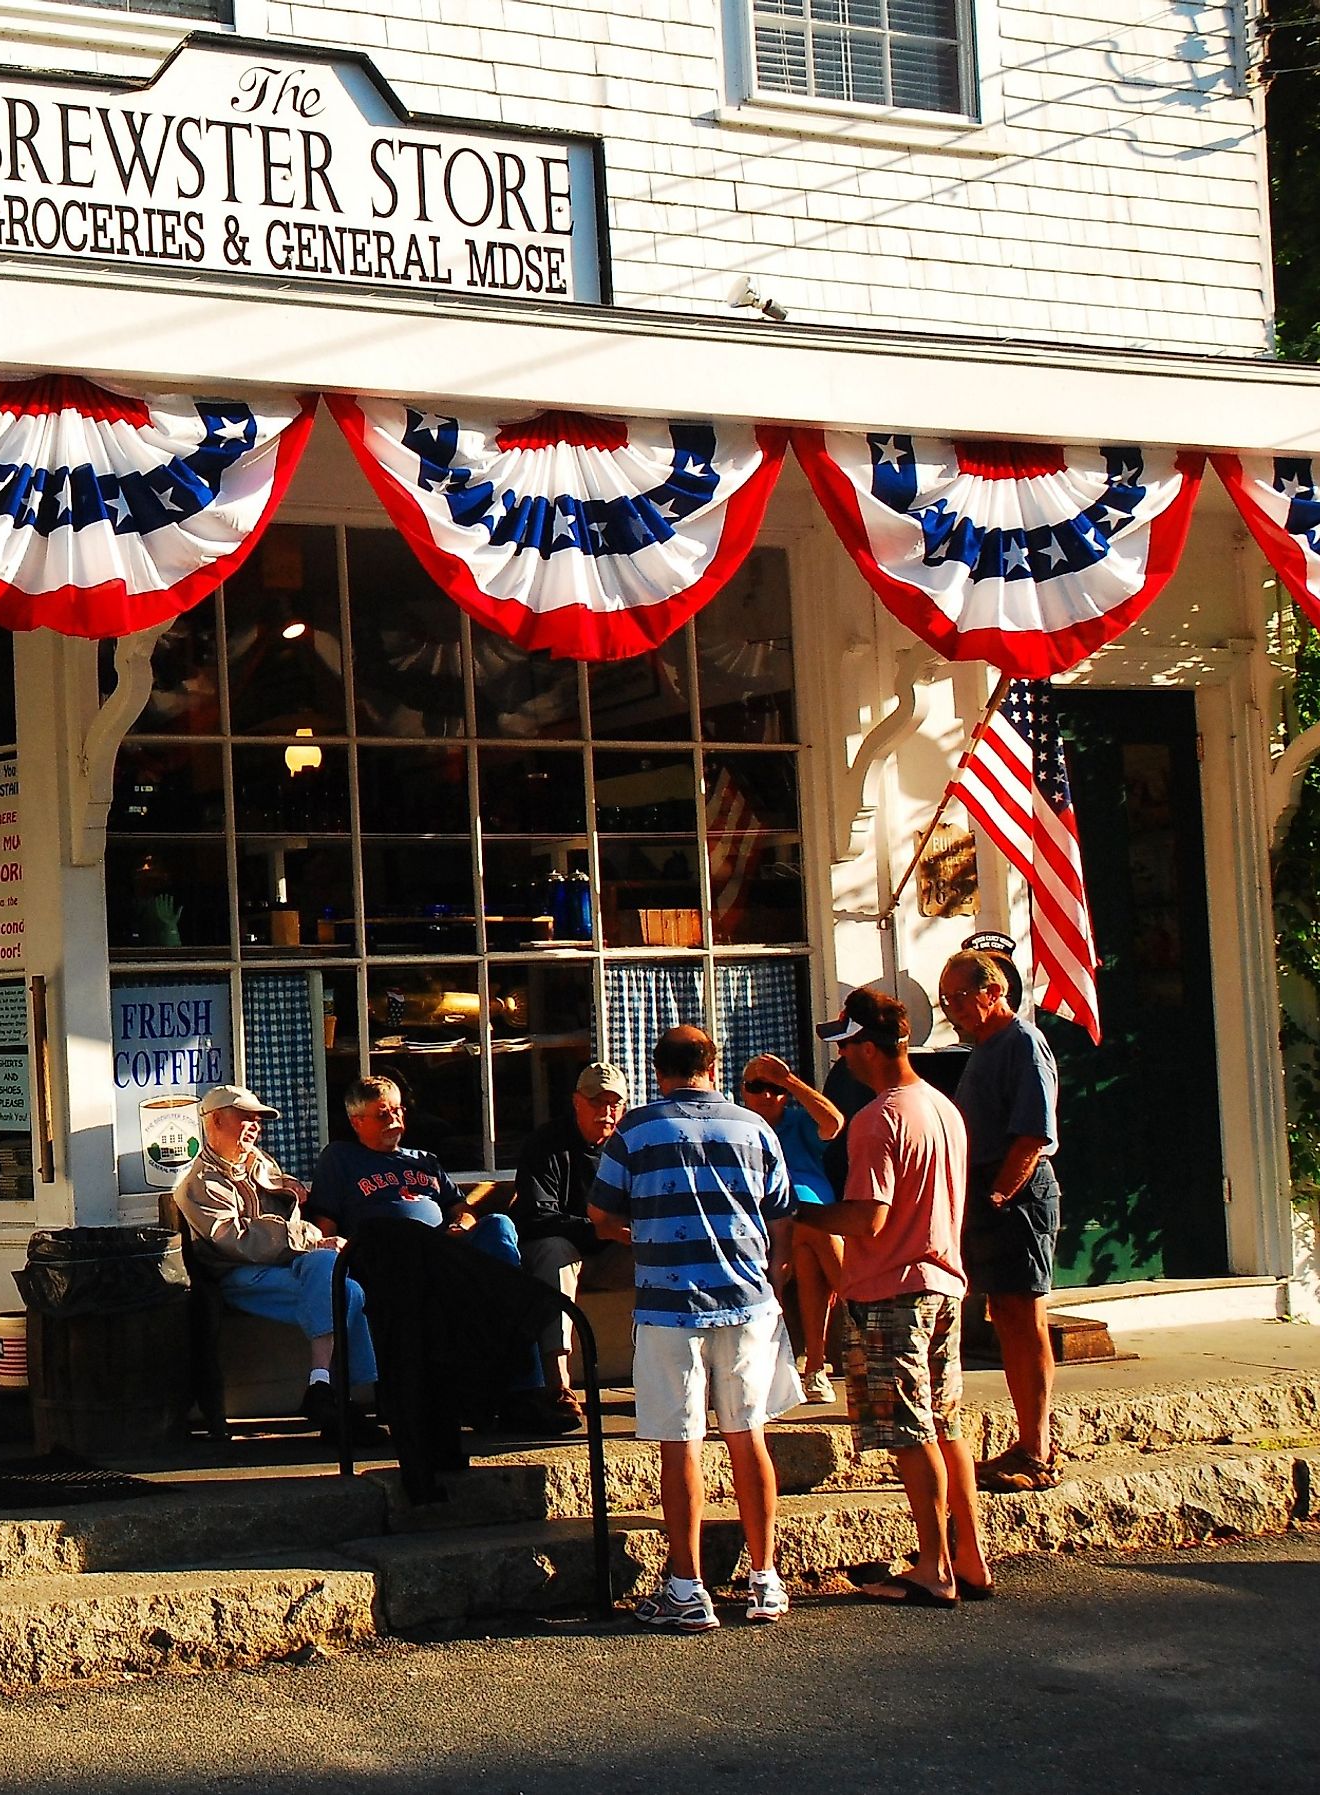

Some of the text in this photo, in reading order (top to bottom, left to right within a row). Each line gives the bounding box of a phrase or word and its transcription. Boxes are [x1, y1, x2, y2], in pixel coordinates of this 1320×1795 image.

[231, 66, 327, 119] The
[370, 137, 575, 237] STORE
[223, 223, 251, 265] &
[265, 218, 452, 285] GENERAL
[465, 240, 568, 295] MDSE
[3, 834, 21, 851] MU
[121, 999, 213, 1040] FRESH
[3, 1072, 19, 1082] AND
[114, 1048, 223, 1088] COFFEE
[357, 1172, 400, 1197] RED
